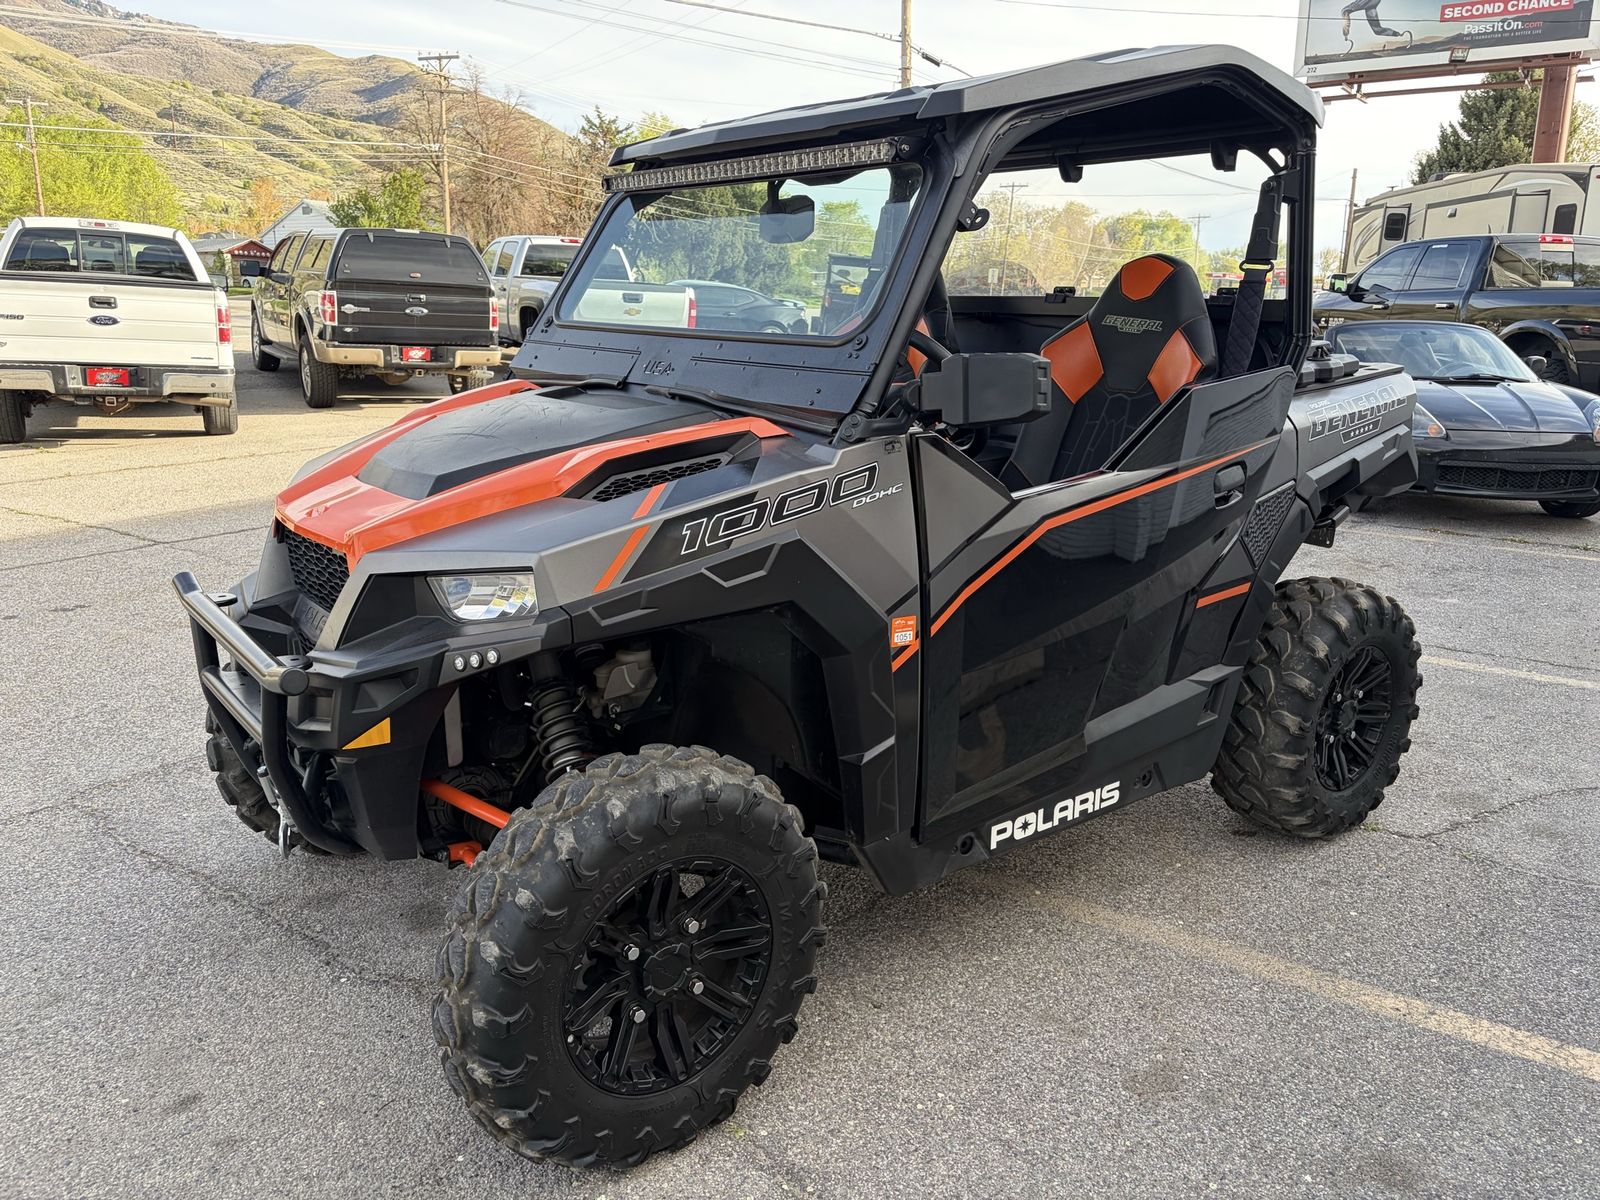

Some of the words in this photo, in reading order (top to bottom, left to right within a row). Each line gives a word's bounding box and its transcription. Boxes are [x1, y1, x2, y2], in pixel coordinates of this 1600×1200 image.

[1444, 3, 1504, 18] SECOND
[1102, 314, 1163, 331] GENERAL
[643, 359, 672, 376] USA
[1307, 384, 1408, 441] GENERAL
[852, 482, 903, 509] DOHC
[680, 462, 879, 555] 1000
[895, 632, 912, 642] 1051
[990, 780, 1121, 850] POLARIS
